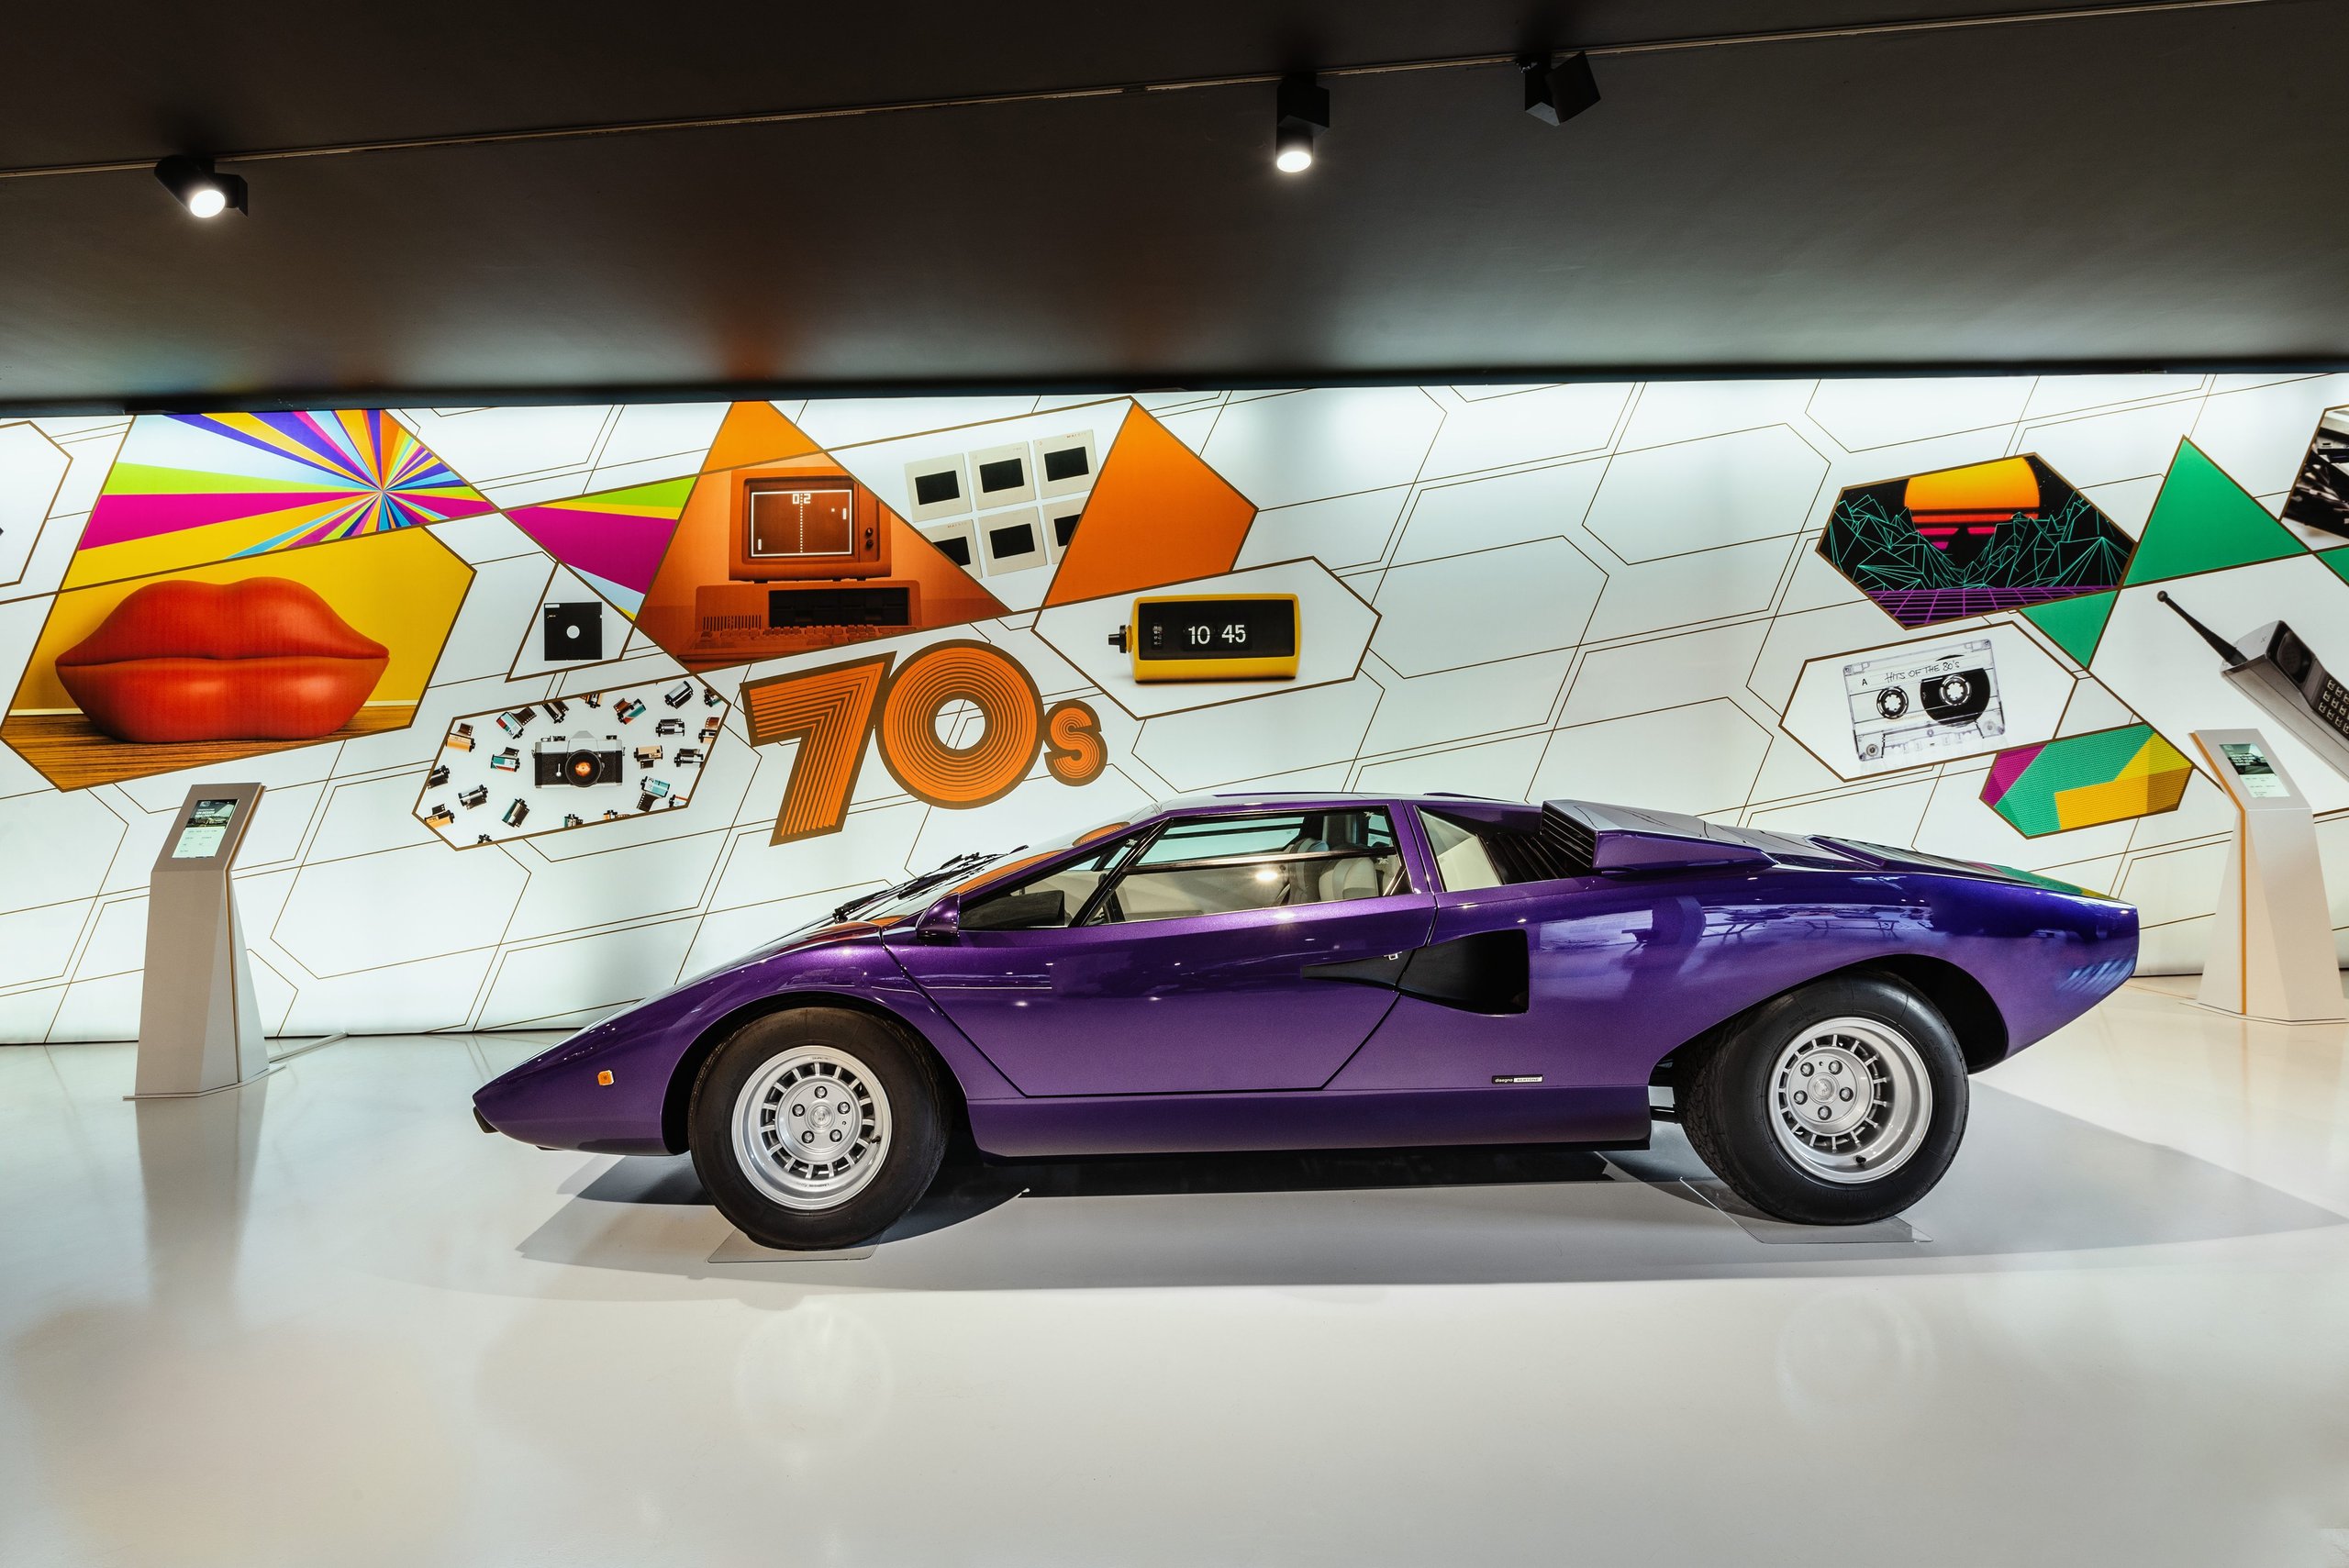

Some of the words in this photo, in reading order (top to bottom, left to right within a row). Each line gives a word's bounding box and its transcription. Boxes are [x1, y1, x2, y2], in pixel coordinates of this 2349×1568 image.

[1188, 625, 1210, 645] 10
[1221, 624, 1247, 644] 45
[1884, 672, 1906, 684] HITS
[1909, 668, 1922, 678] OF
[1923, 664, 1940, 673] THE
[740, 639, 1108, 847] 70s
